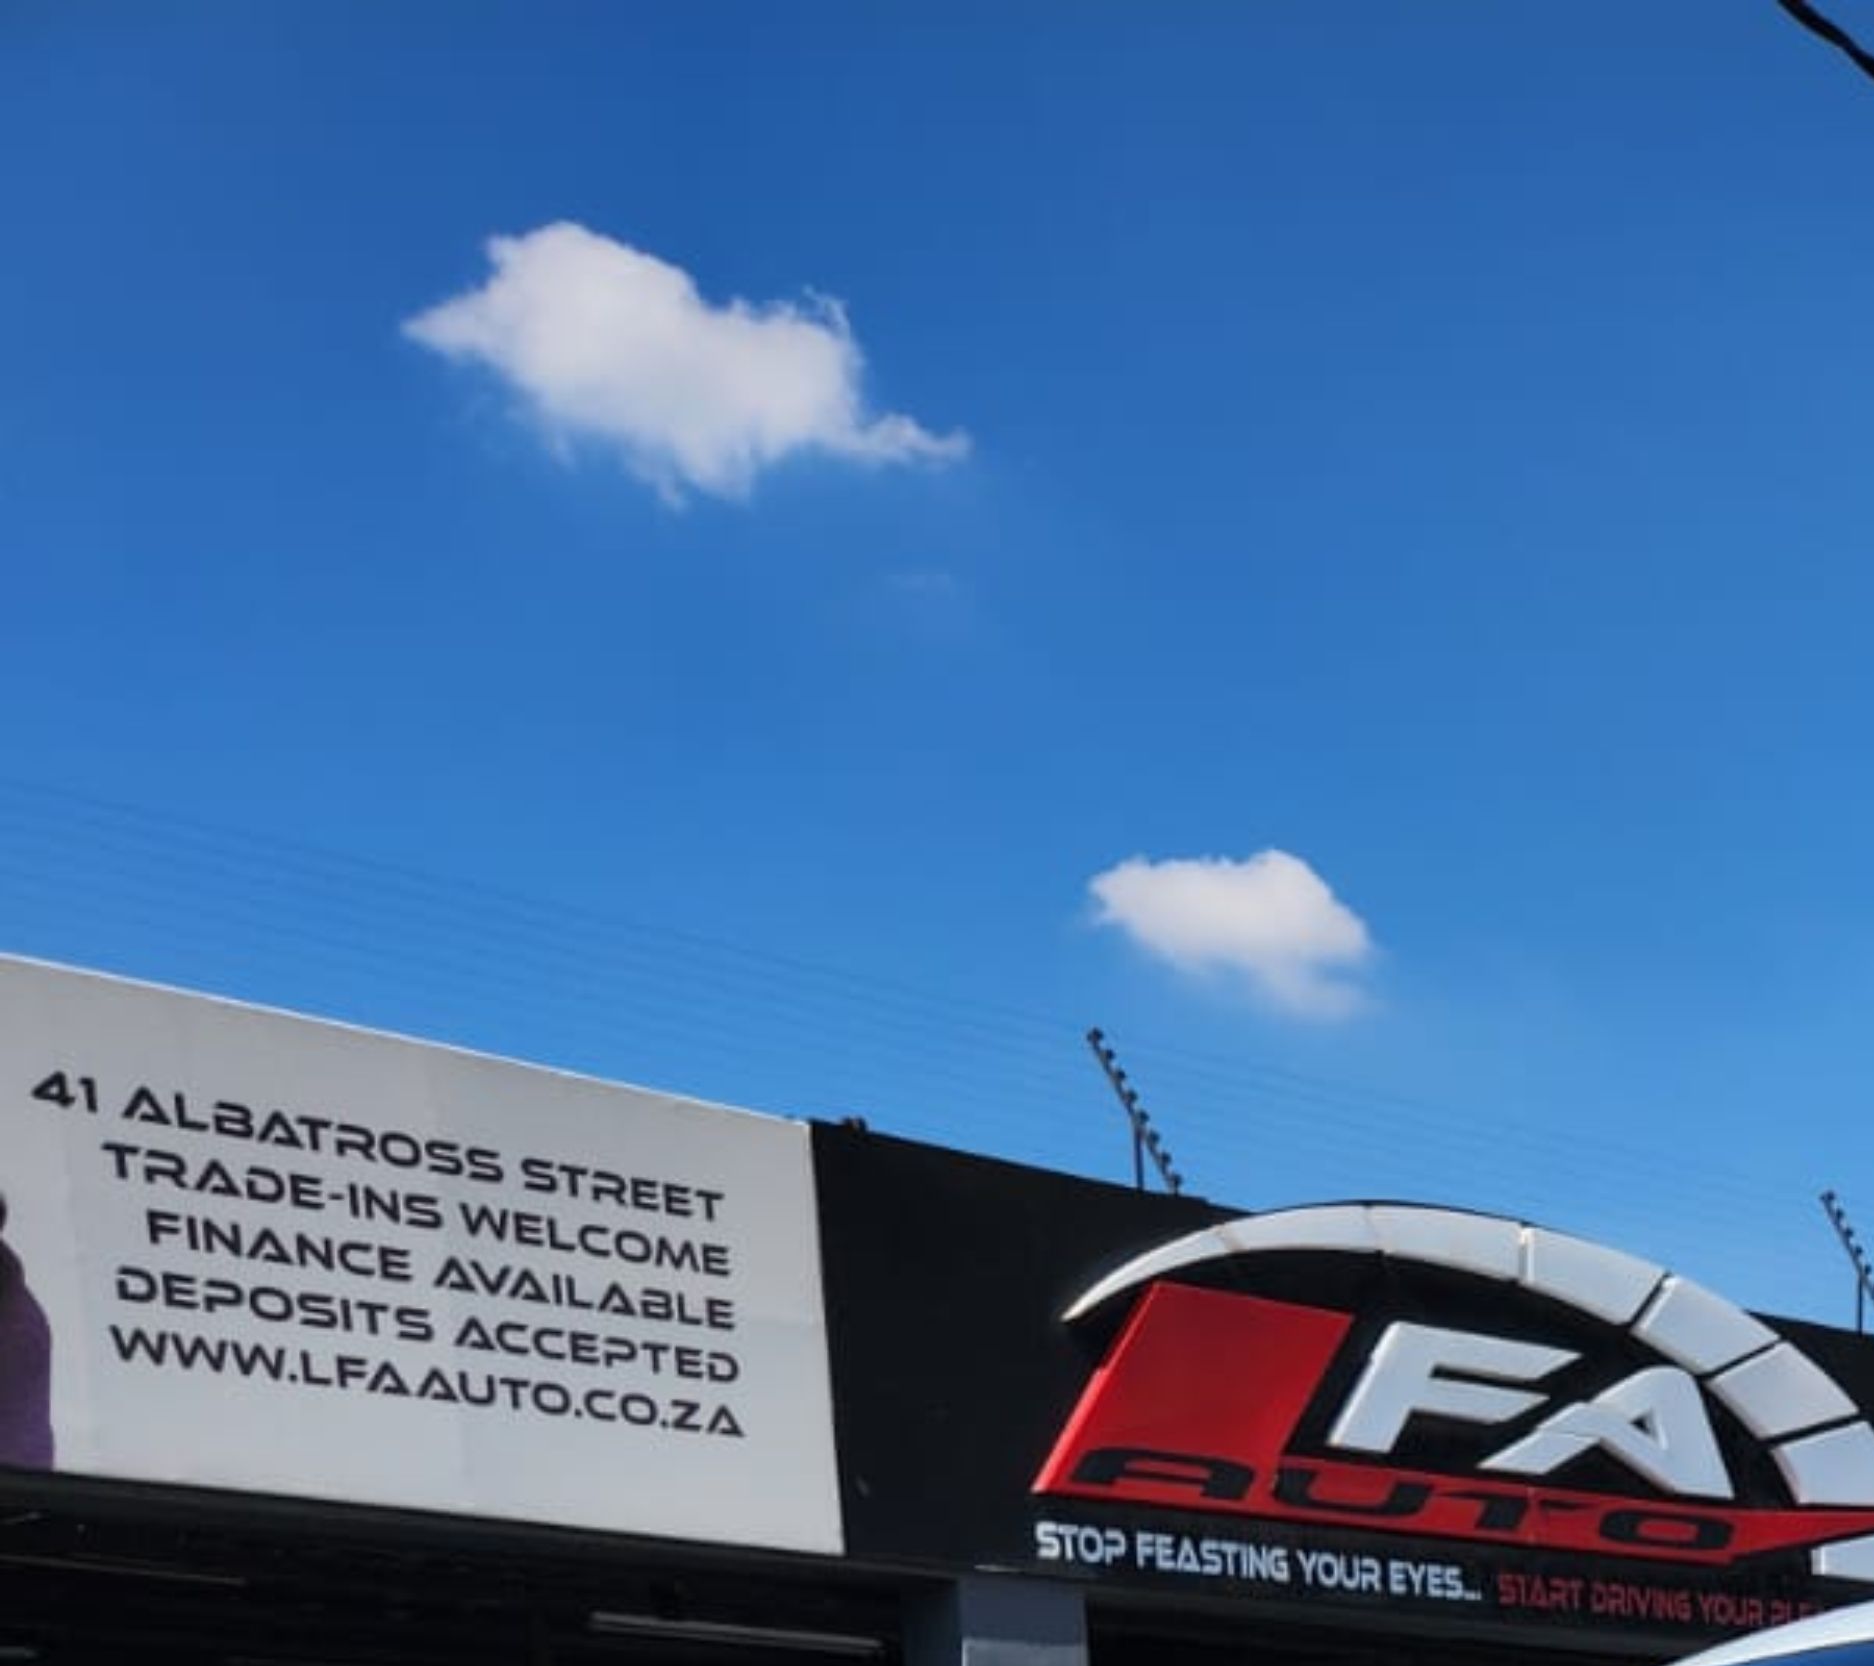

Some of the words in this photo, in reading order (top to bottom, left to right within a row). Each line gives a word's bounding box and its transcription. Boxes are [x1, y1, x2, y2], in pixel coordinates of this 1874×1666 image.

[31, 1070, 98, 1114] 41
[121, 1085, 505, 1184] ALBATROSS
[519, 1157, 726, 1222] STREET
[100, 1141, 444, 1230] TRADE-INS
[458, 1201, 732, 1277] WELCOME
[115, 1265, 435, 1342] DEPOSITS
[453, 1315, 741, 1384] ACCEPTED
[146, 1208, 413, 1283] FINANCE
[433, 1255, 737, 1331] AVAILABLE
[108, 1324, 747, 1439] WWW.LFAAUTO.CO.ZA
[1070, 1447, 1737, 1552] AUTO
[1035, 1520, 1127, 1564] STOP
[1136, 1531, 1291, 1583] FEASTING
[1296, 1550, 1383, 1594] YOUR
[1496, 1573, 1584, 1610] START
[1590, 1580, 1692, 1623] DRIVING
[1700, 1593, 1763, 1626] YOUR
